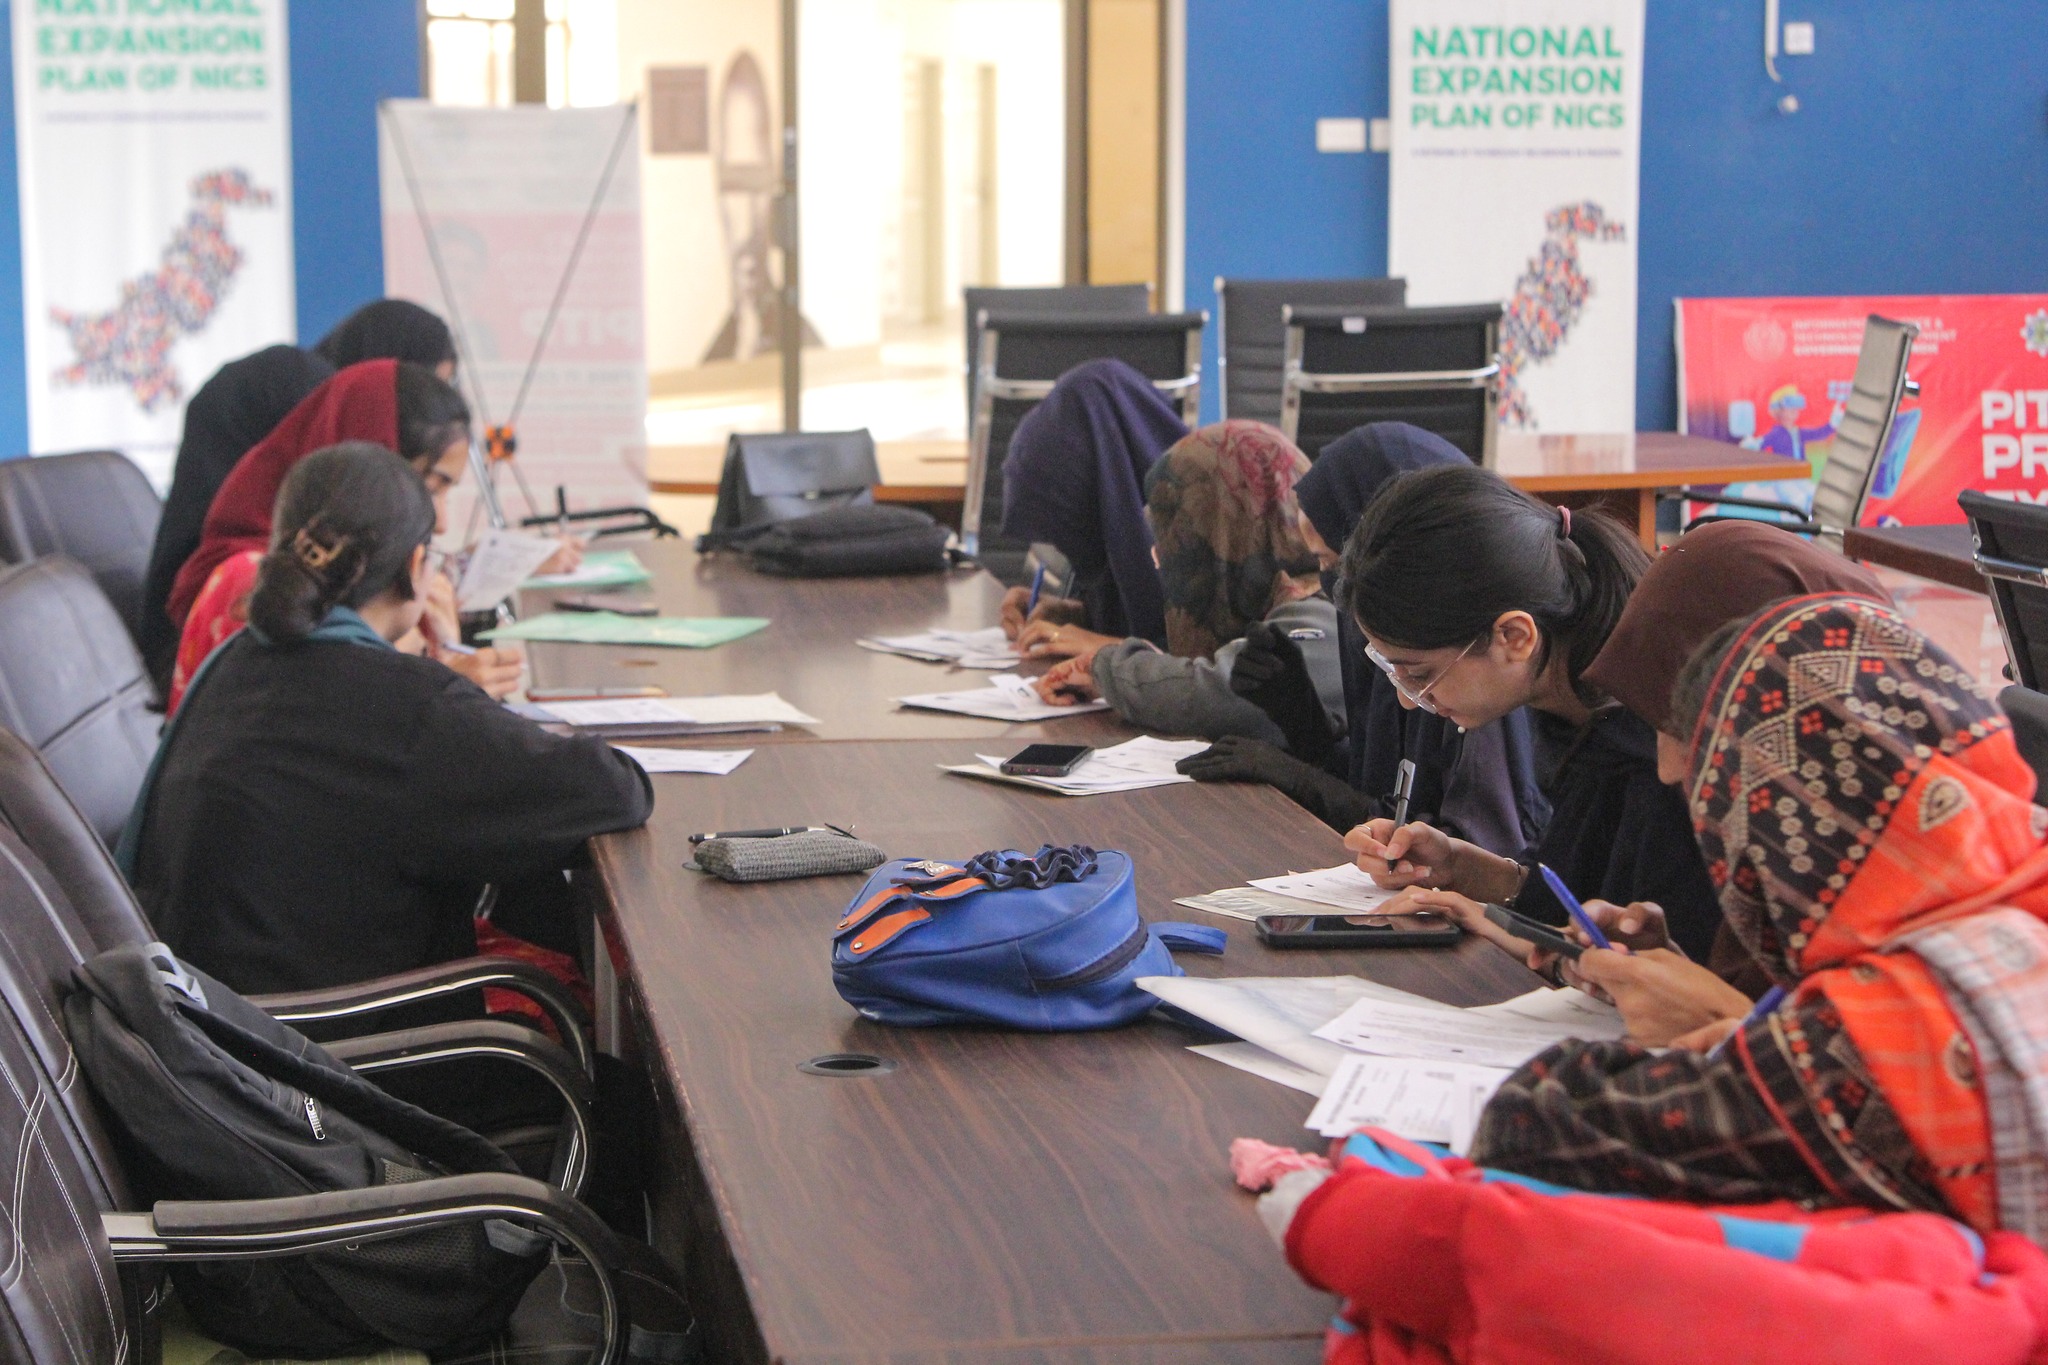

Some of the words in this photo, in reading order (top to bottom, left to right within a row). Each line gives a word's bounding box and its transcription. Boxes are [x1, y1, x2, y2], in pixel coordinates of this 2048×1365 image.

[38, 26, 264, 55] EXPANSION
[1411, 26, 1623, 58] NATIONAL
[40, 66, 127, 90] PLAN
[138, 66, 177, 90] OF
[191, 66, 266, 90] NICS
[1411, 66, 1622, 94] EXPANSION
[1411, 104, 1492, 127] PLAN
[1502, 104, 1540, 127] OF
[1553, 104, 1624, 127] NICS
[1981, 389, 2048, 429] PIT
[1982, 433, 2048, 479] PR
